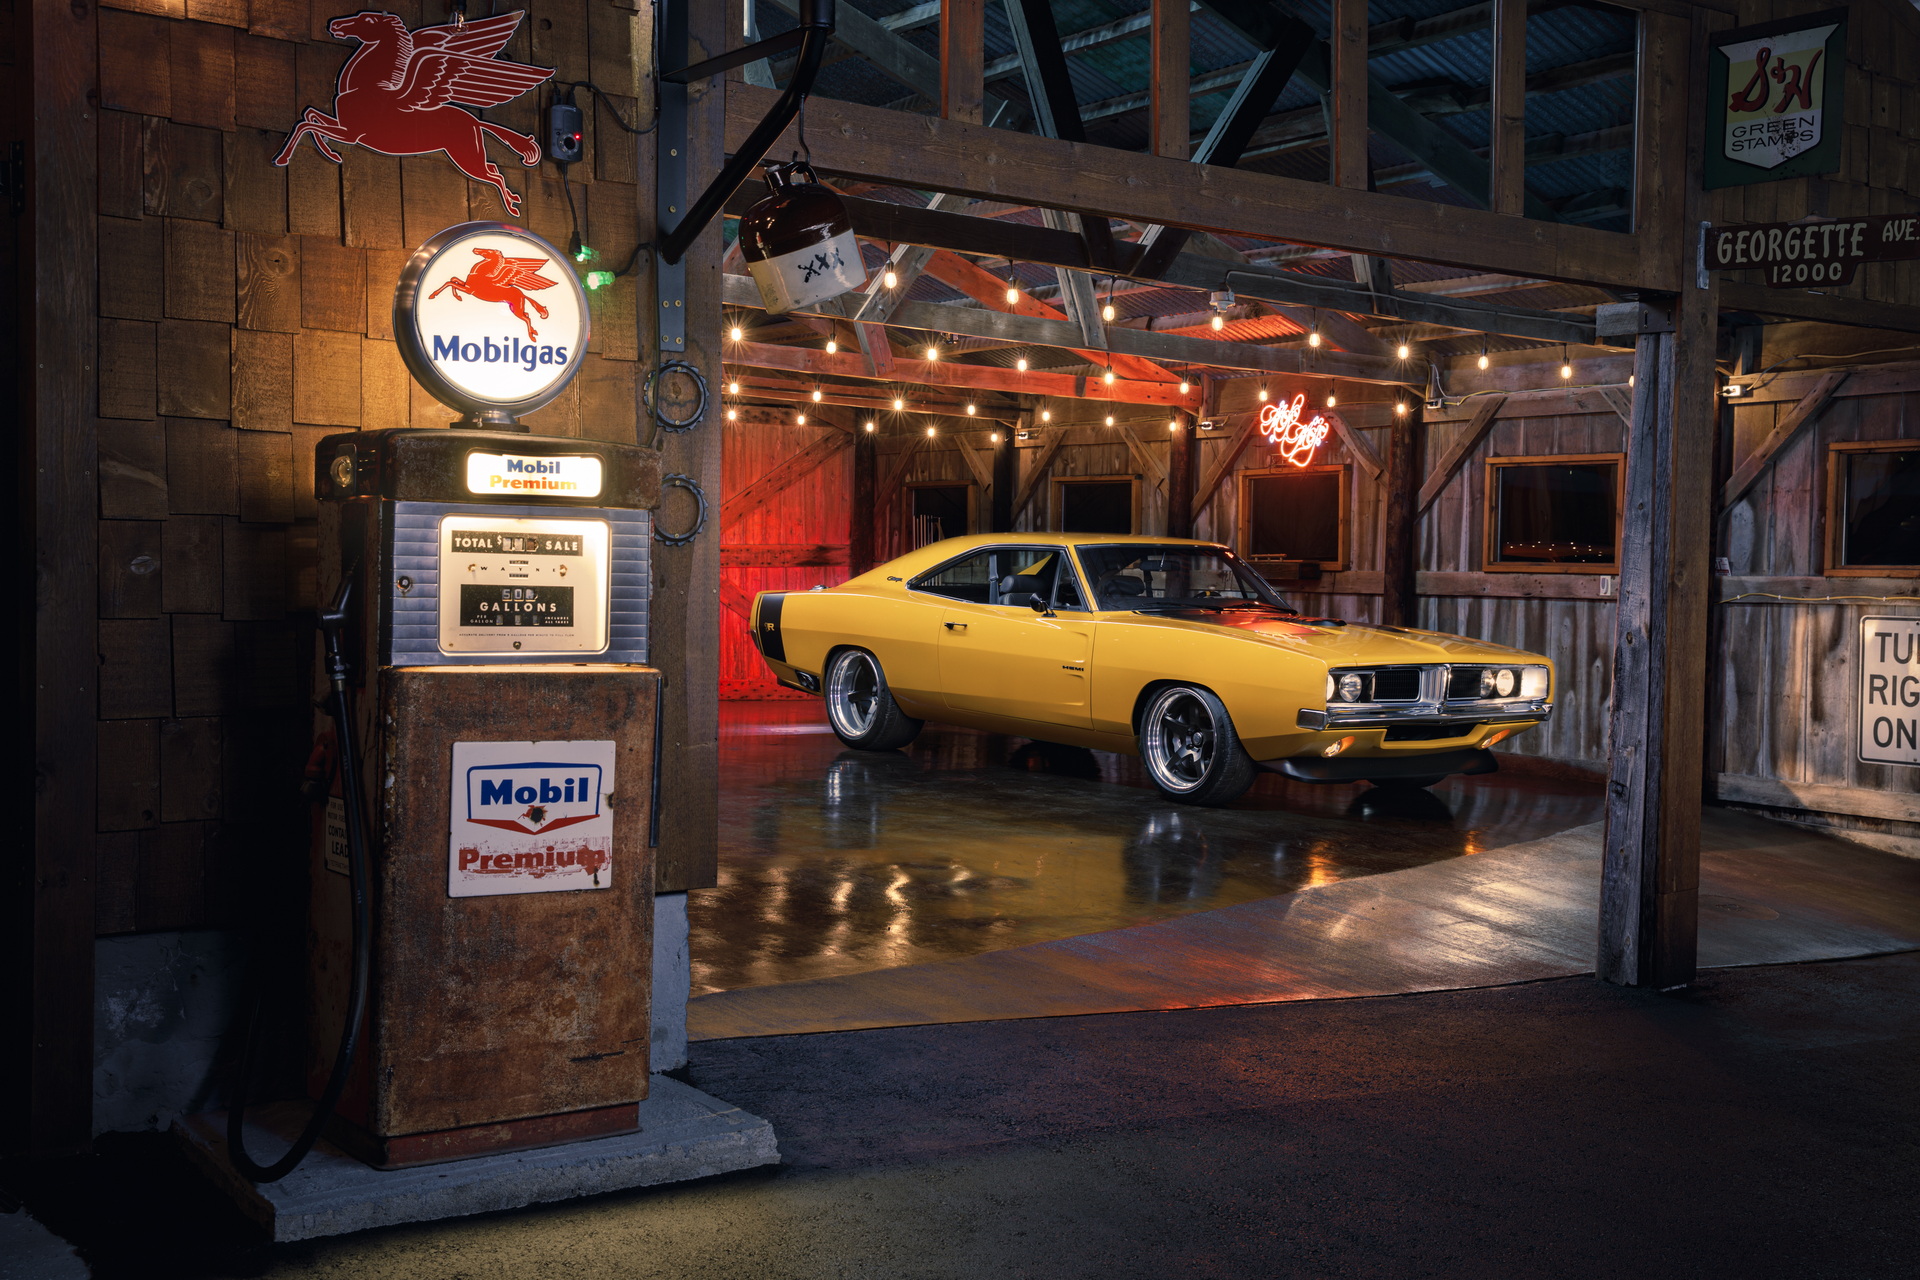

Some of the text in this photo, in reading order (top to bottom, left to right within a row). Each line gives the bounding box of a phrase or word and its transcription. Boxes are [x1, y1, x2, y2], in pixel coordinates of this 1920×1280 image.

[1732, 115, 1815, 138] GREEN
[1731, 129, 1814, 152] STAMPS
[1717, 223, 1867, 264] GEORGETTE
[797, 247, 844, 283] XXX
[1773, 263, 1842, 283] 12000
[433, 335, 568, 371] Mobilgas
[507, 459, 561, 474] Mobil
[489, 475, 577, 490] Premium
[455, 537, 493, 548] TOTAL
[545, 540, 578, 551] SALE
[480, 602, 557, 612] GALLONS
[480, 777, 589, 806] Mobil
[458, 845, 607, 872] Premium
